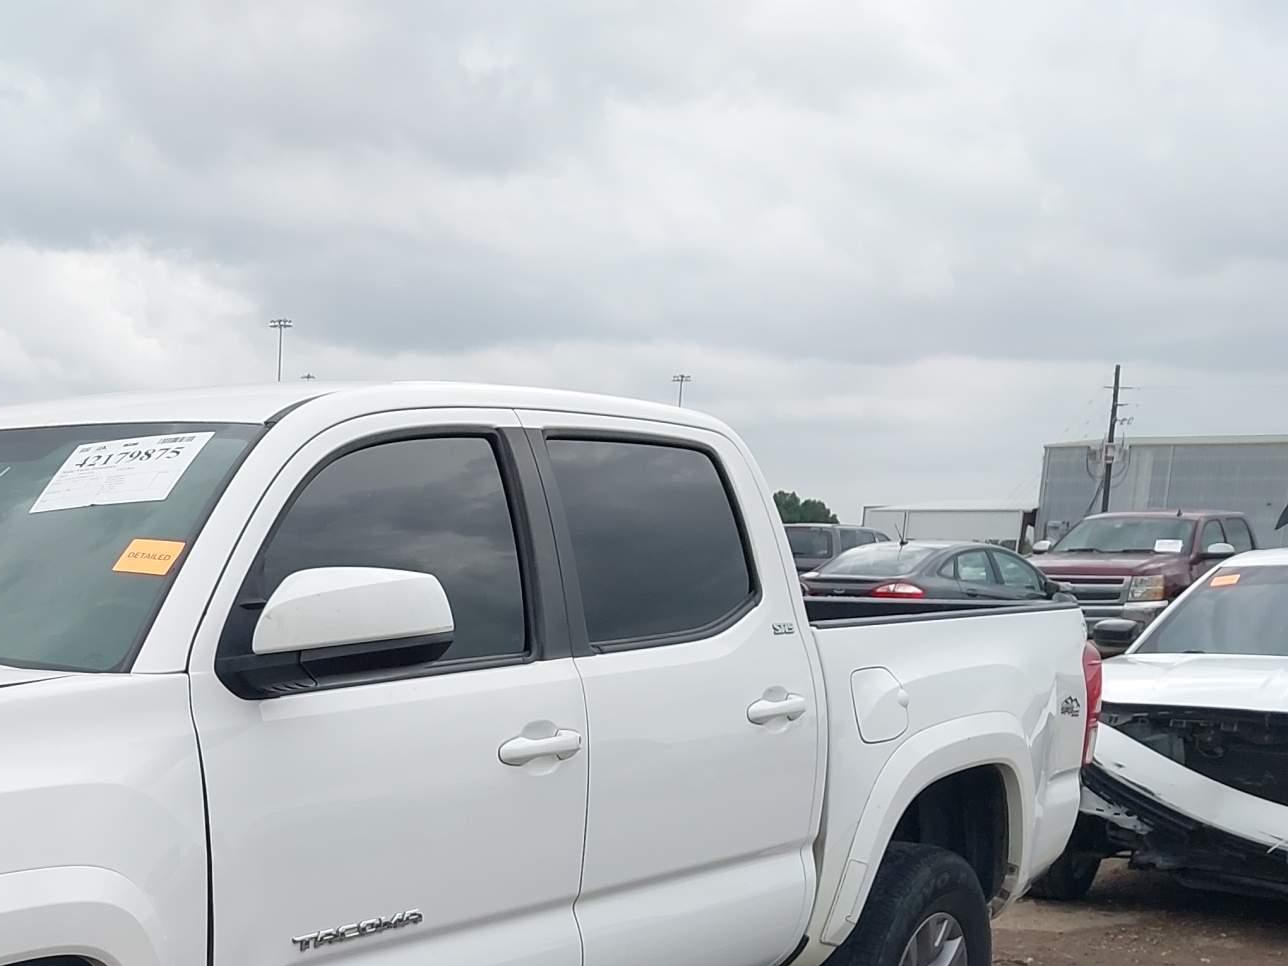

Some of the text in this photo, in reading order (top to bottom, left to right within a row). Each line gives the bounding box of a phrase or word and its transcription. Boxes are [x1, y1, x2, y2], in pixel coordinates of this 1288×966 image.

[75, 446, 185, 468] 42179875
[127, 550, 171, 562] DETAILED
[291, 908, 423, 952] TACOMA
